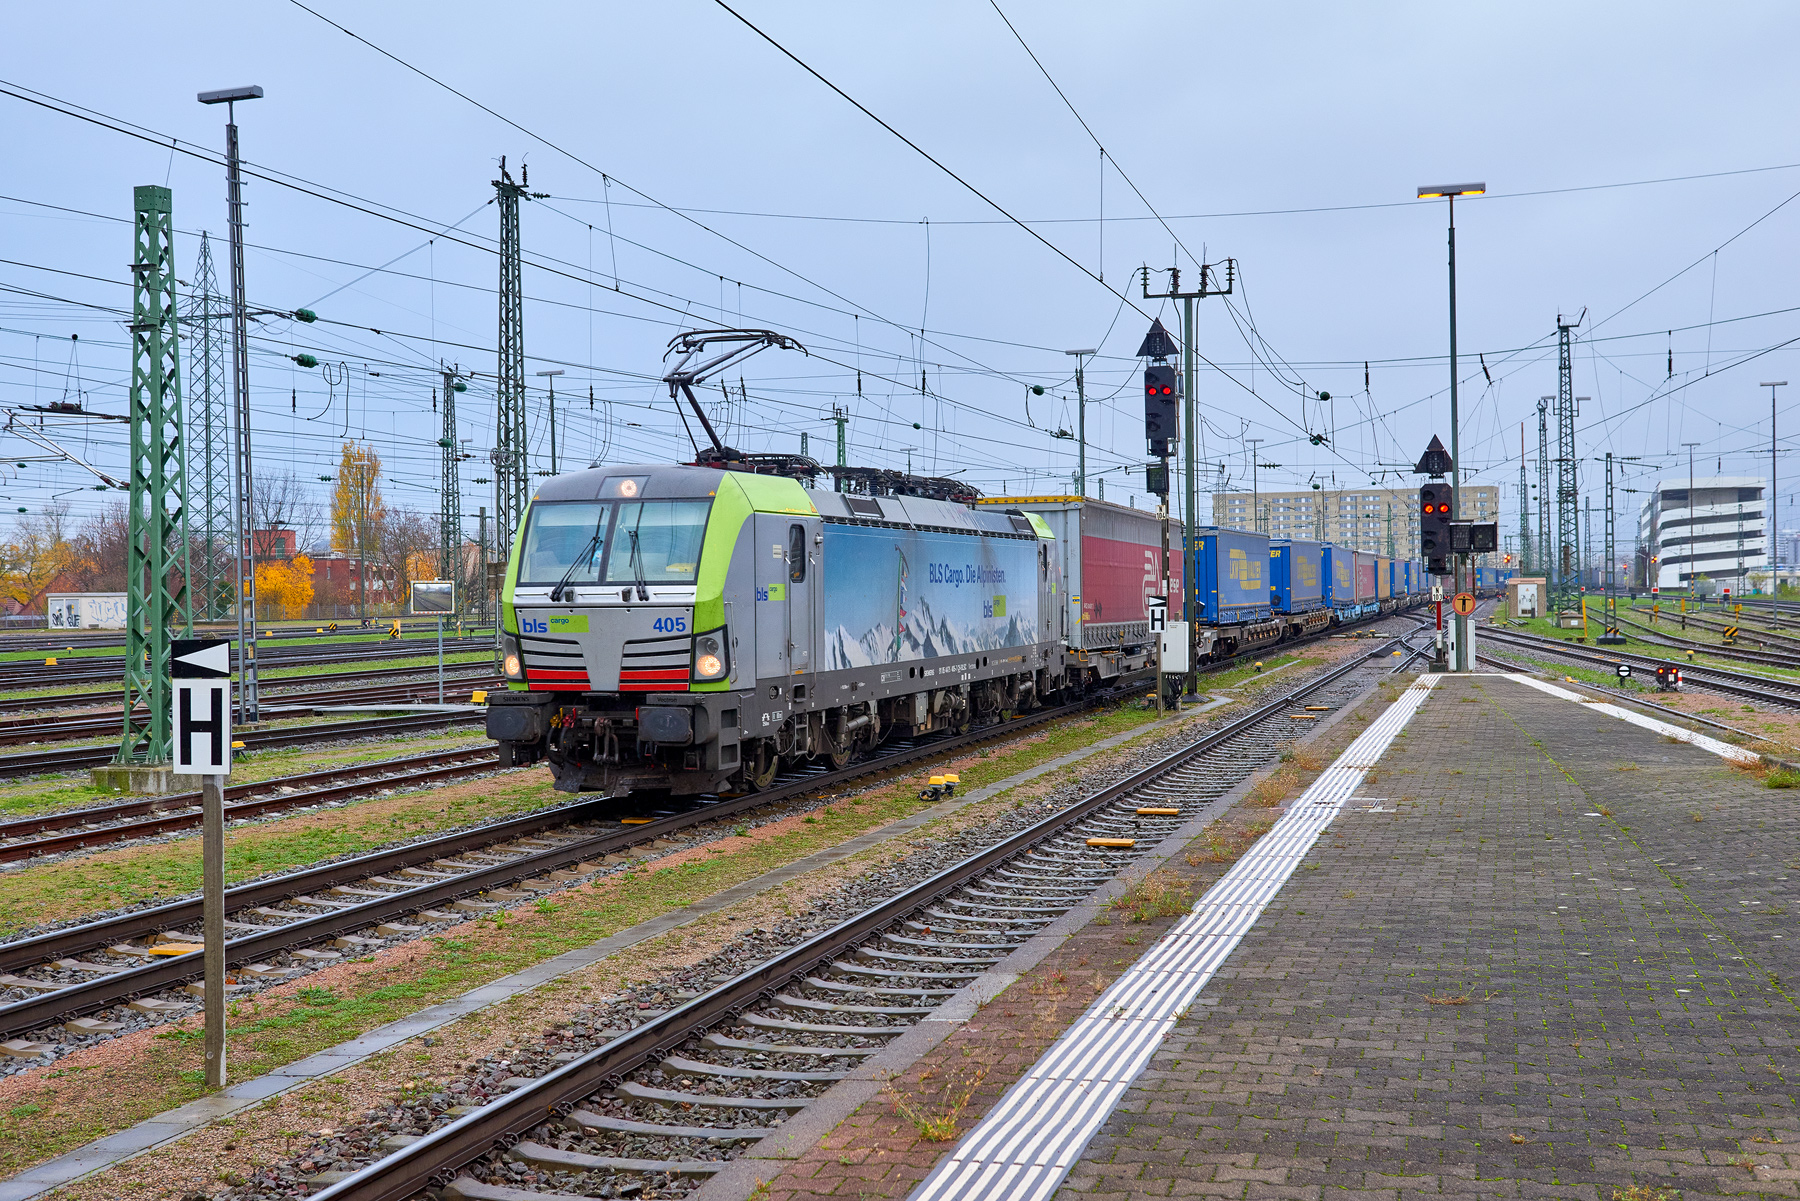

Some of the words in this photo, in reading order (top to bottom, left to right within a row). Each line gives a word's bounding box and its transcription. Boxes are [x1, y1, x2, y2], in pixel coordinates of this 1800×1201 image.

[1269, 550, 1281, 558] ER
[929, 563, 943, 584] BLS
[944, 563, 965, 588] Cargo.
[965, 564, 976, 584] Die
[976, 564, 1007, 588] Alpinisten.
[756, 587, 769, 601] bls
[983, 600, 993, 618] bls
[522, 618, 548, 633] bls
[550, 617, 570, 625] cargo
[653, 617, 687, 633] 405
[1150, 609, 1165, 631] H
[179, 687, 223, 766] H
